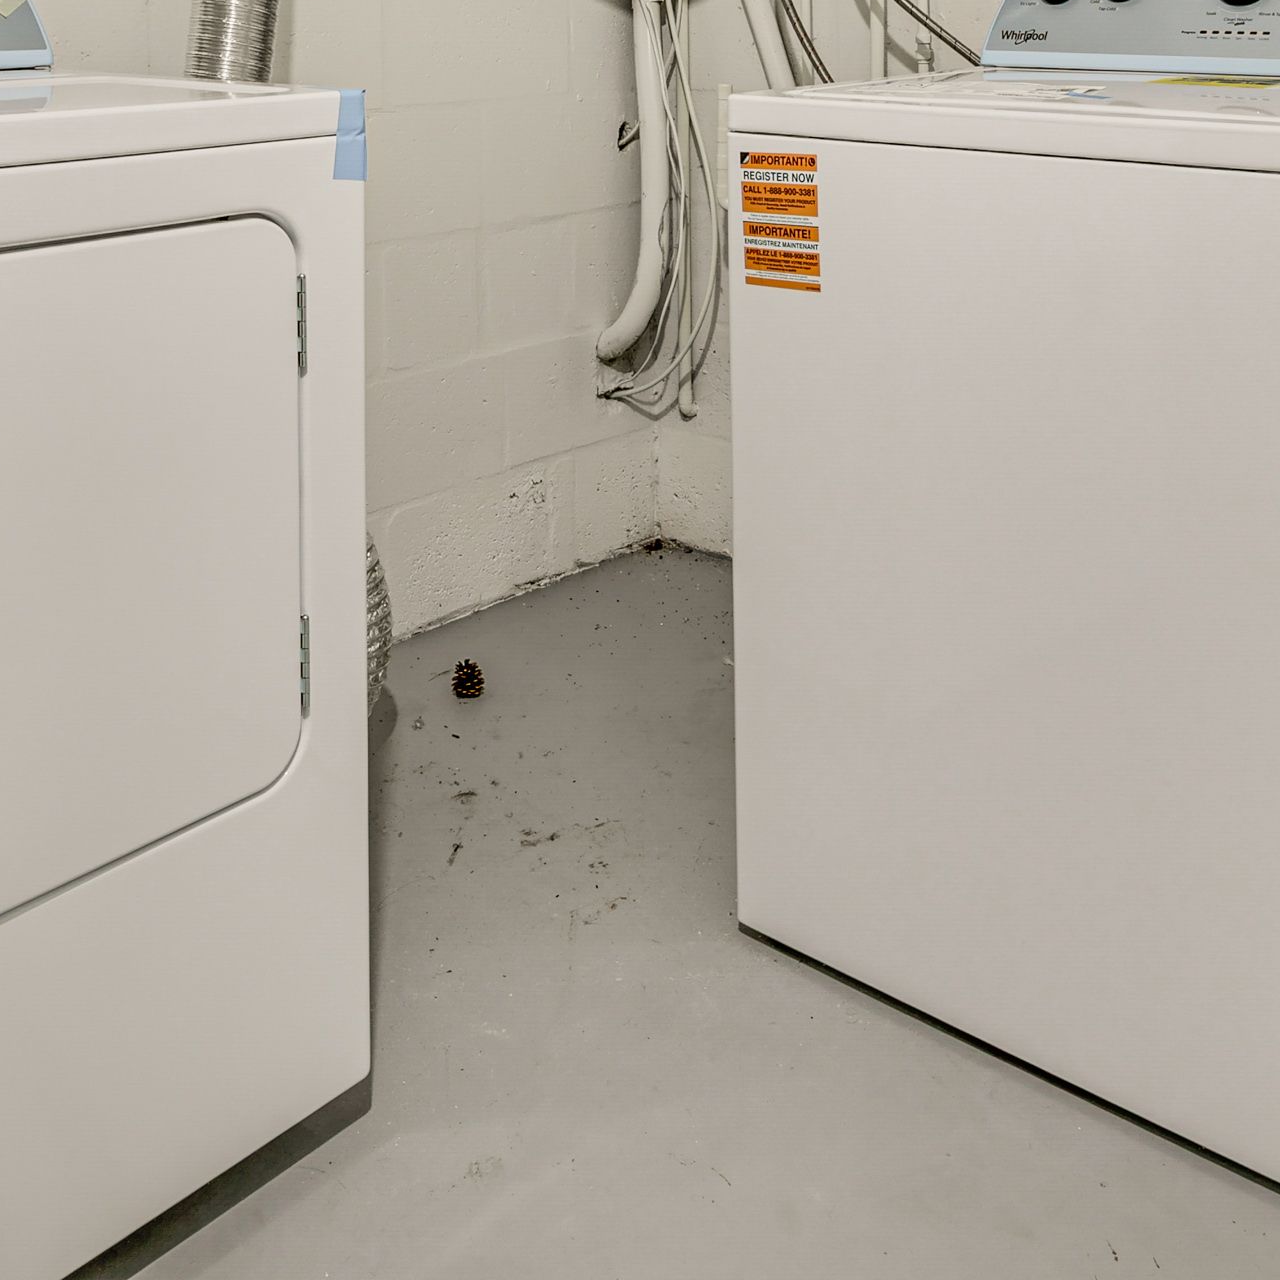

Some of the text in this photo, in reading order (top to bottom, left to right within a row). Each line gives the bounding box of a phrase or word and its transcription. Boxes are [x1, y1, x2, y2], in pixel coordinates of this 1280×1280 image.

[1001, 29, 1048, 45] Whirlpool
[750, 155, 807, 167] IMPORTANT!
[743, 170, 814, 183] REGISTER NOW
[742, 185, 815, 197] CALL 1-888-900-3381
[748, 225, 811, 239] IMPORTANTE!
[744, 238, 818, 250] ENREGISTREZ MAINTENANT
[746, 248, 770, 257] APPELEZ
